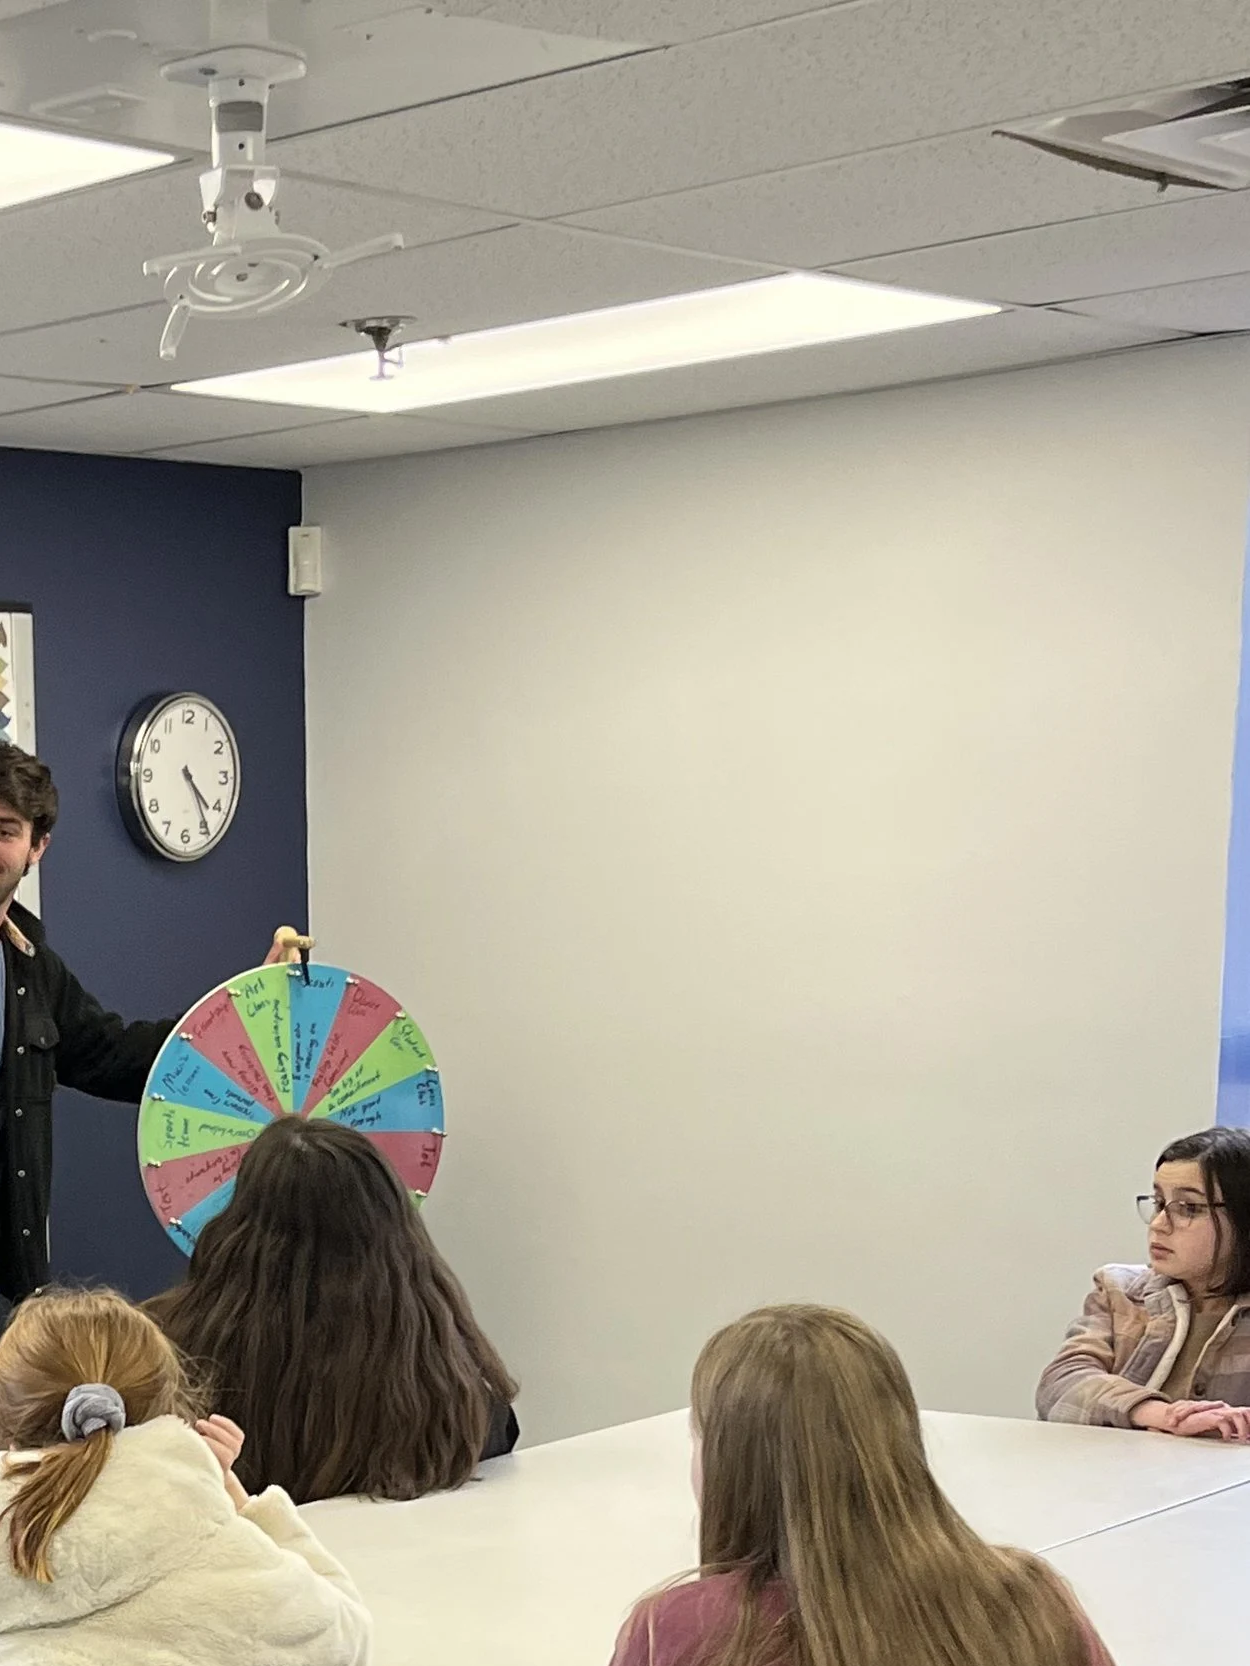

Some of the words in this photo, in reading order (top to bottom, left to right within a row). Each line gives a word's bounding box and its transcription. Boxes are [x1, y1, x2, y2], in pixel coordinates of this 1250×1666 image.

[182, 709, 195, 724] 12
[164, 718, 172, 734] 11
[204, 717, 208, 732] 1
[150, 739, 161, 753] 10
[213, 740, 224, 755] 2
[142, 768, 153, 783] 9
[218, 770, 229, 786] 3
[148, 799, 159, 813] 8
[212, 799, 222, 812] 4
[162, 820, 171, 836] 7
[180, 828, 191, 844] 6
[245, 977, 265, 999] Art
[420, 1143, 438, 1168] Job
